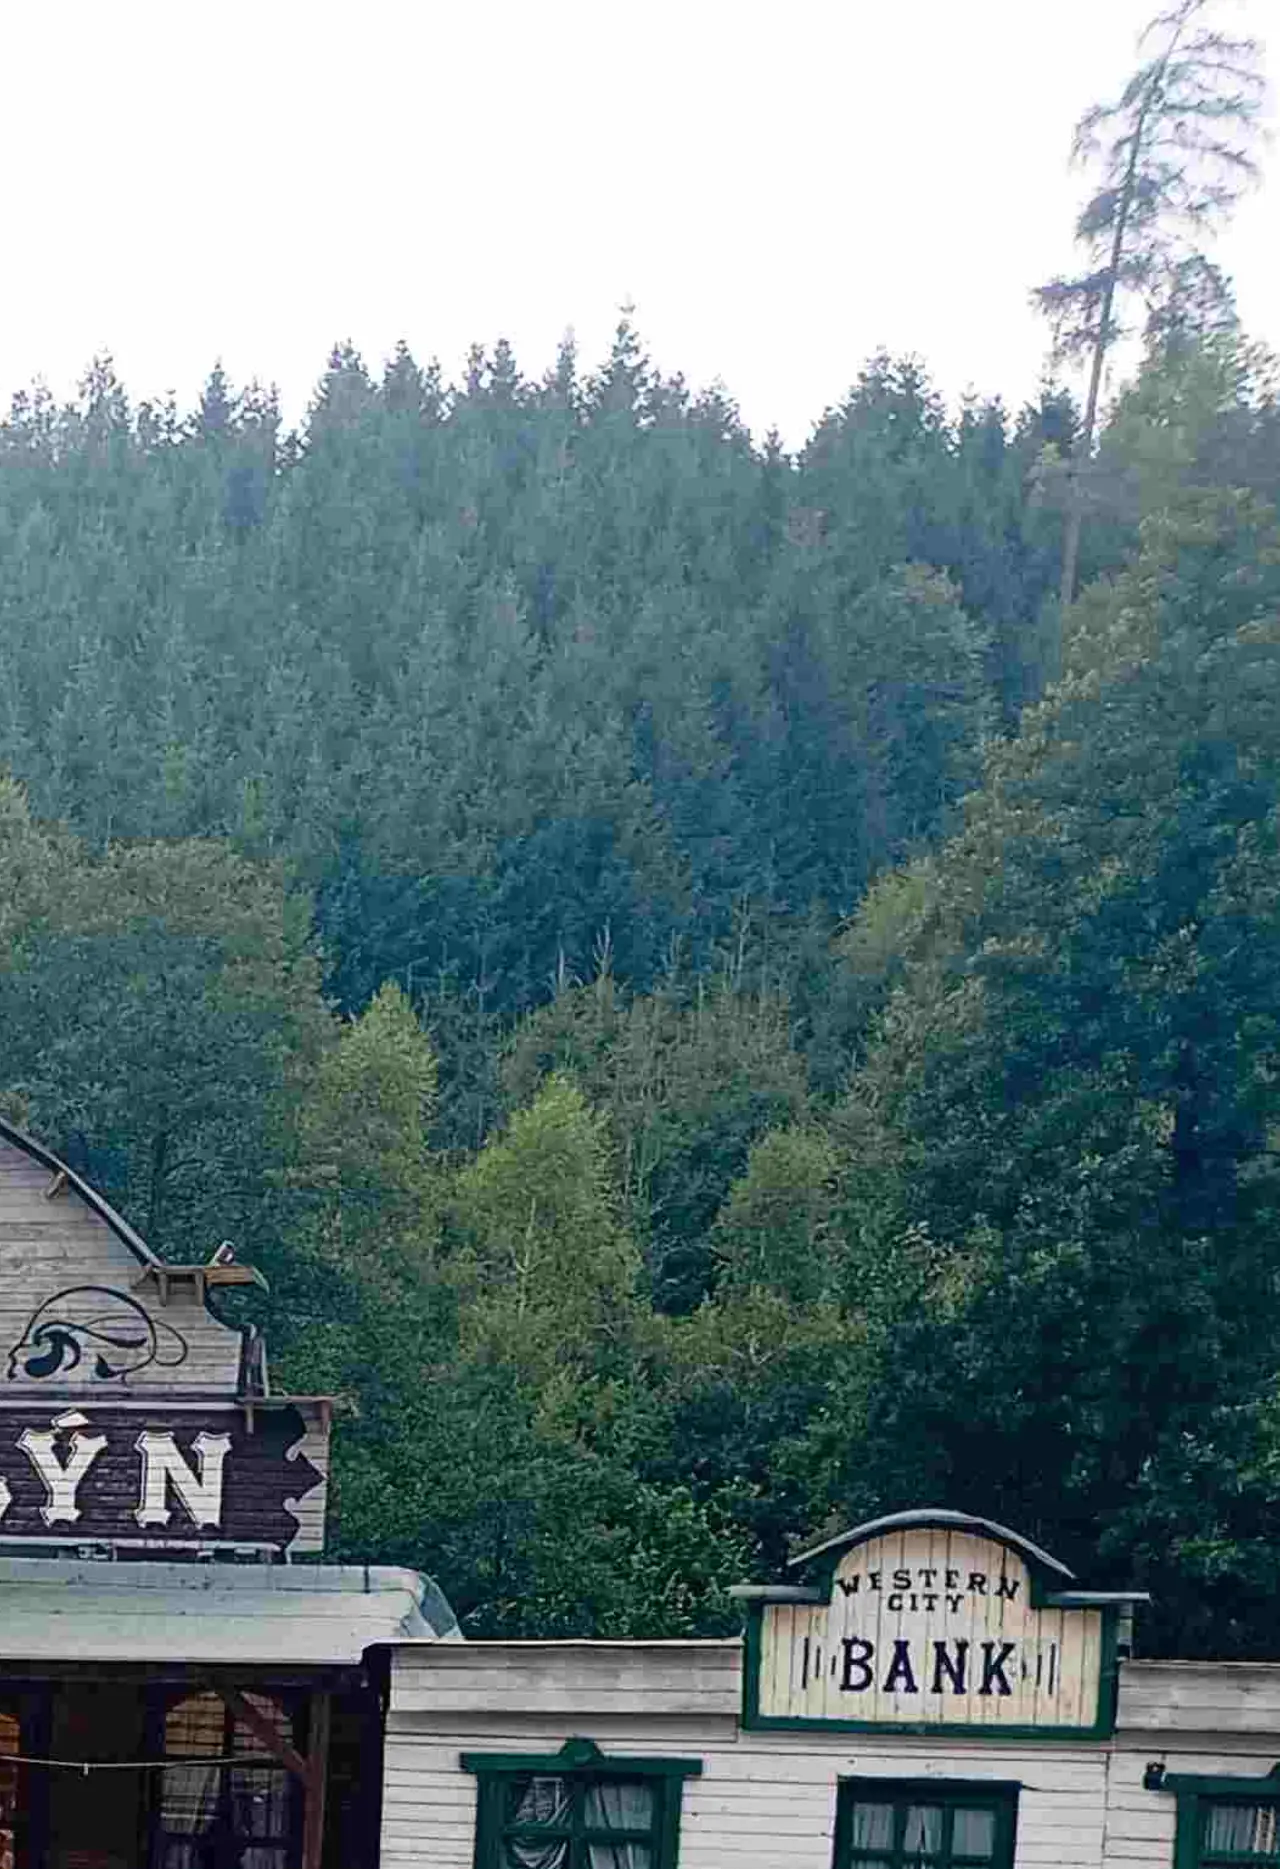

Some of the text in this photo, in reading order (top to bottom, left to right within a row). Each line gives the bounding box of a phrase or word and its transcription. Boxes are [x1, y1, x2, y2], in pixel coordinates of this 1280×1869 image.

[837, 1567, 1020, 1600] WESTERN
[887, 1593, 964, 1614] CITY
[839, 1636, 1017, 1696] BANK
